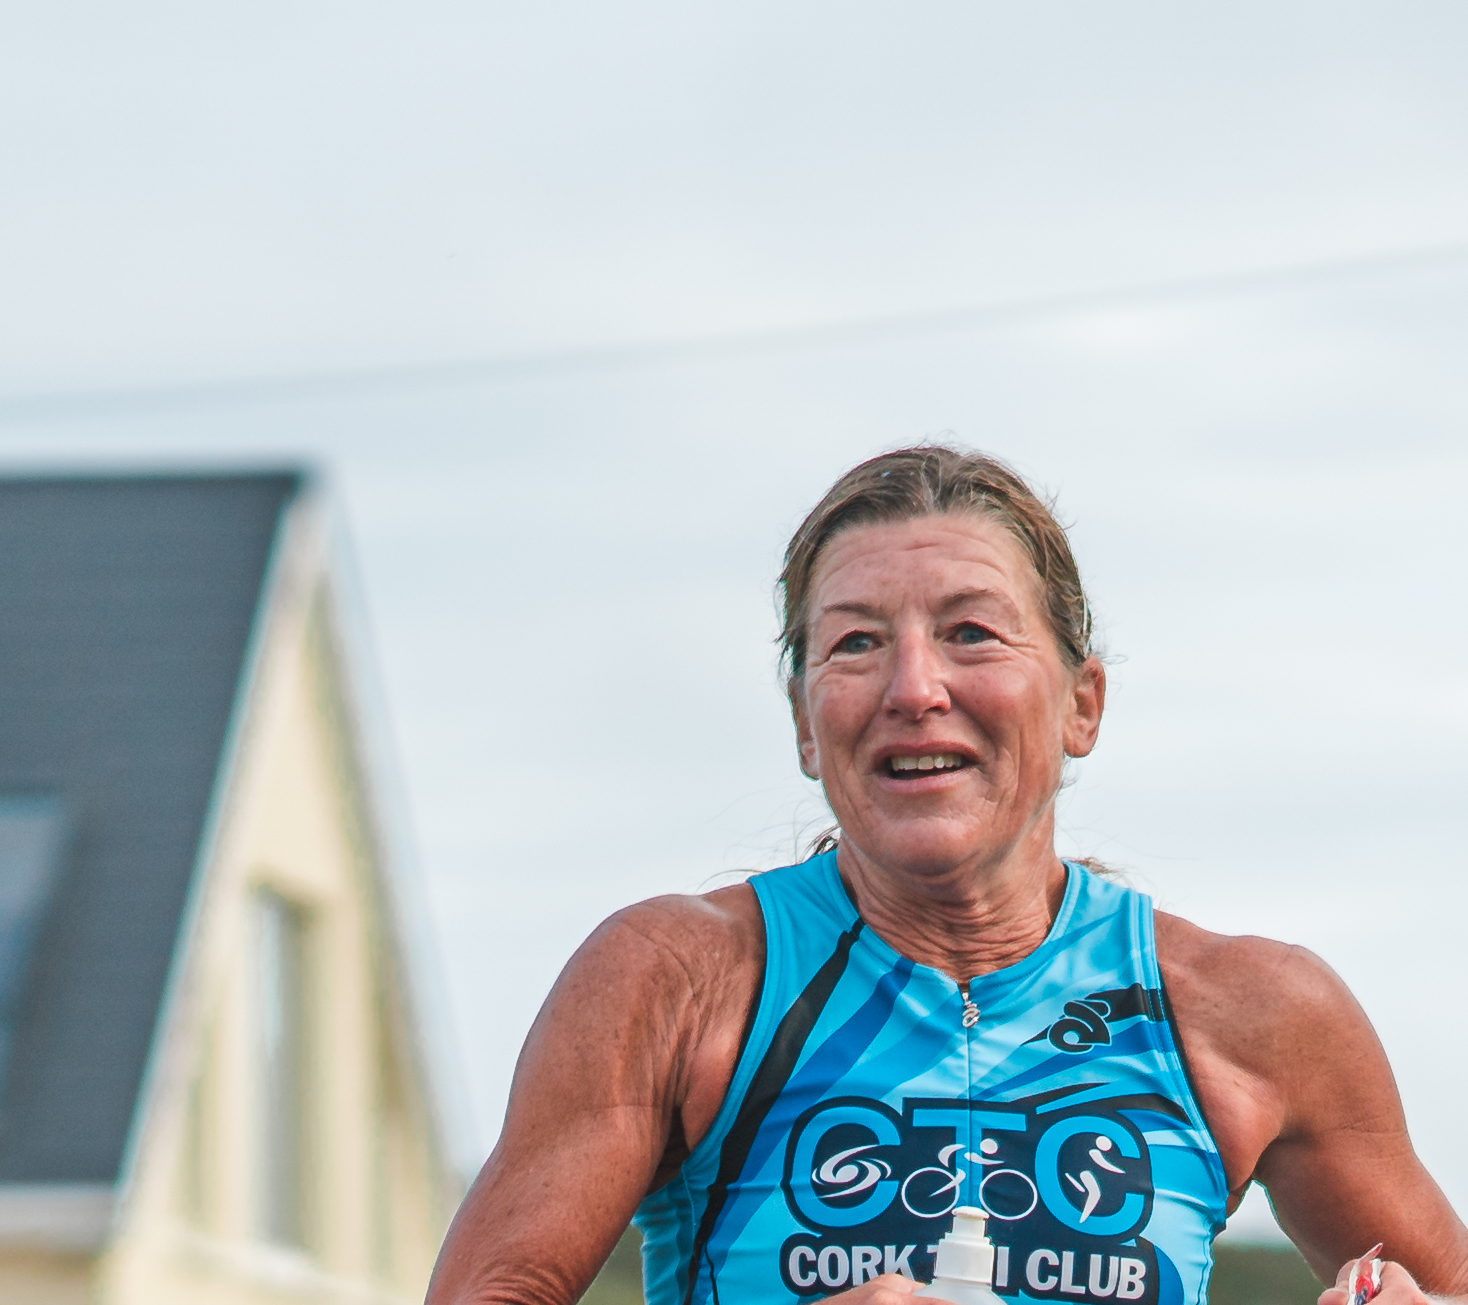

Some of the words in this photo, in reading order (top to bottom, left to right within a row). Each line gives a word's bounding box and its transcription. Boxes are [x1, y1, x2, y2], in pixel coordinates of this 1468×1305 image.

[792, 1106, 1145, 1236] CTC
[789, 1245, 916, 1288] CORK
[1027, 1248, 1146, 1300] CLUB
